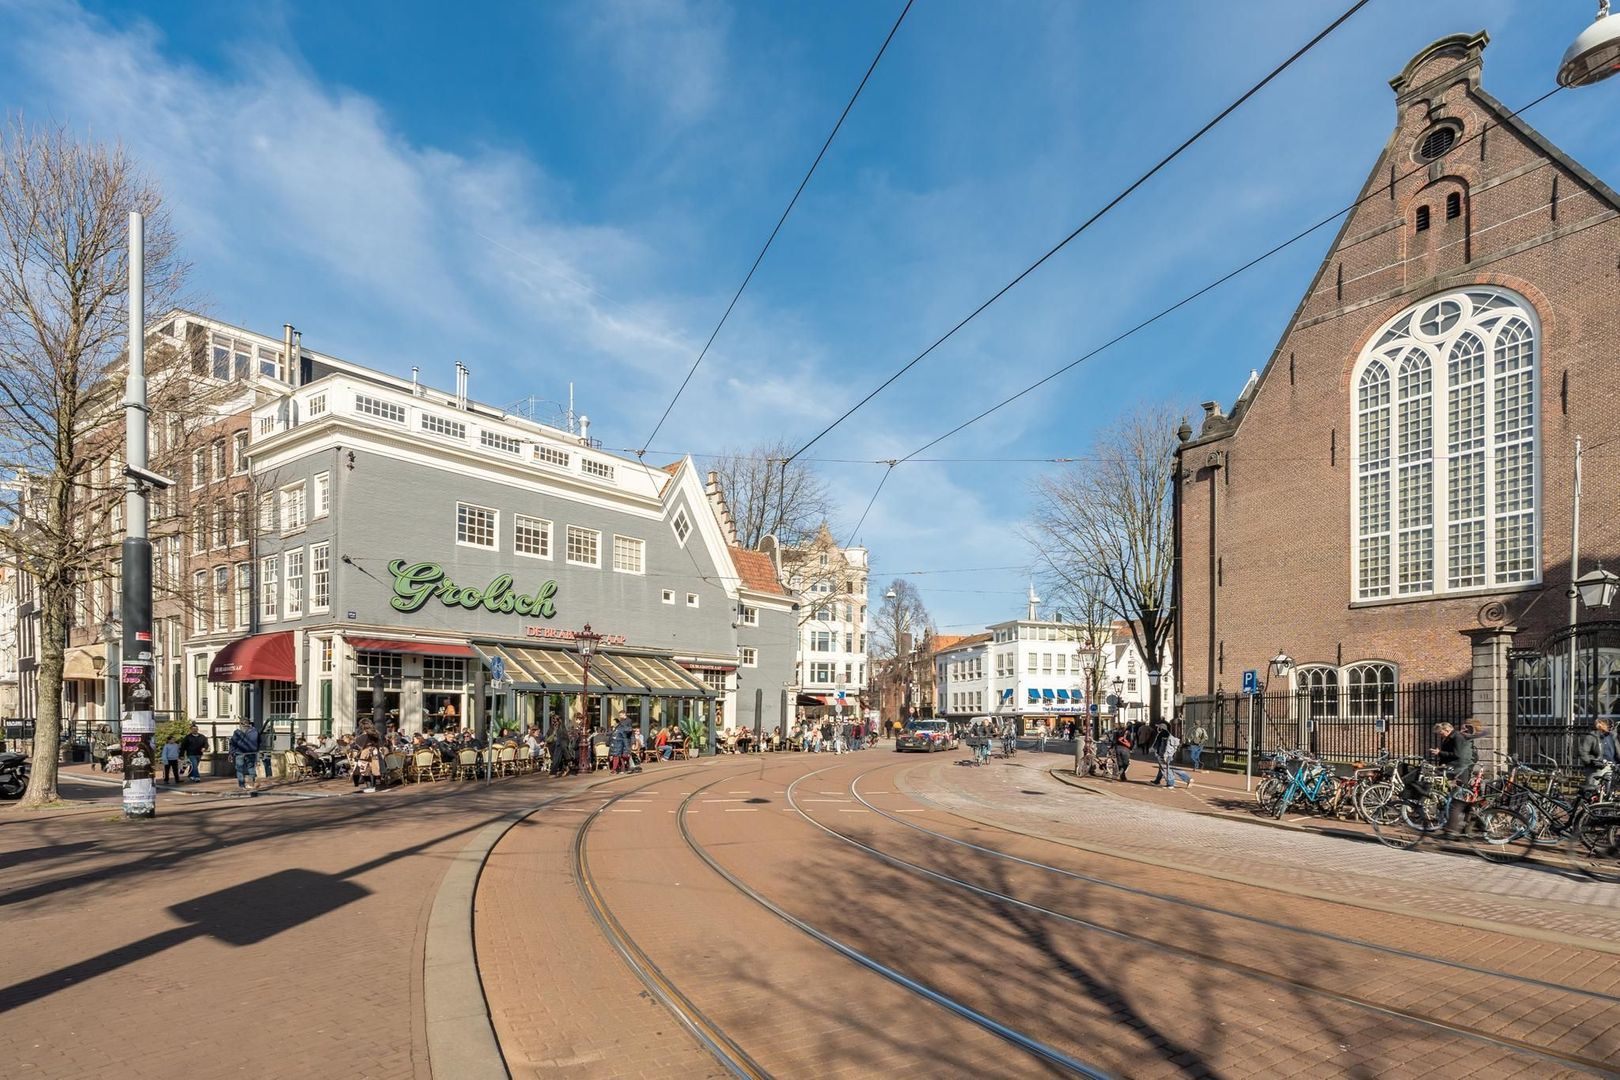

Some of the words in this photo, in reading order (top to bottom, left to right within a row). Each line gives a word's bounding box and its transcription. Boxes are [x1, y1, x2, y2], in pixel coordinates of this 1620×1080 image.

[388, 558, 558, 619] Grolsch
[527, 626, 541, 636] DE
[1245, 672, 1252, 685] P
